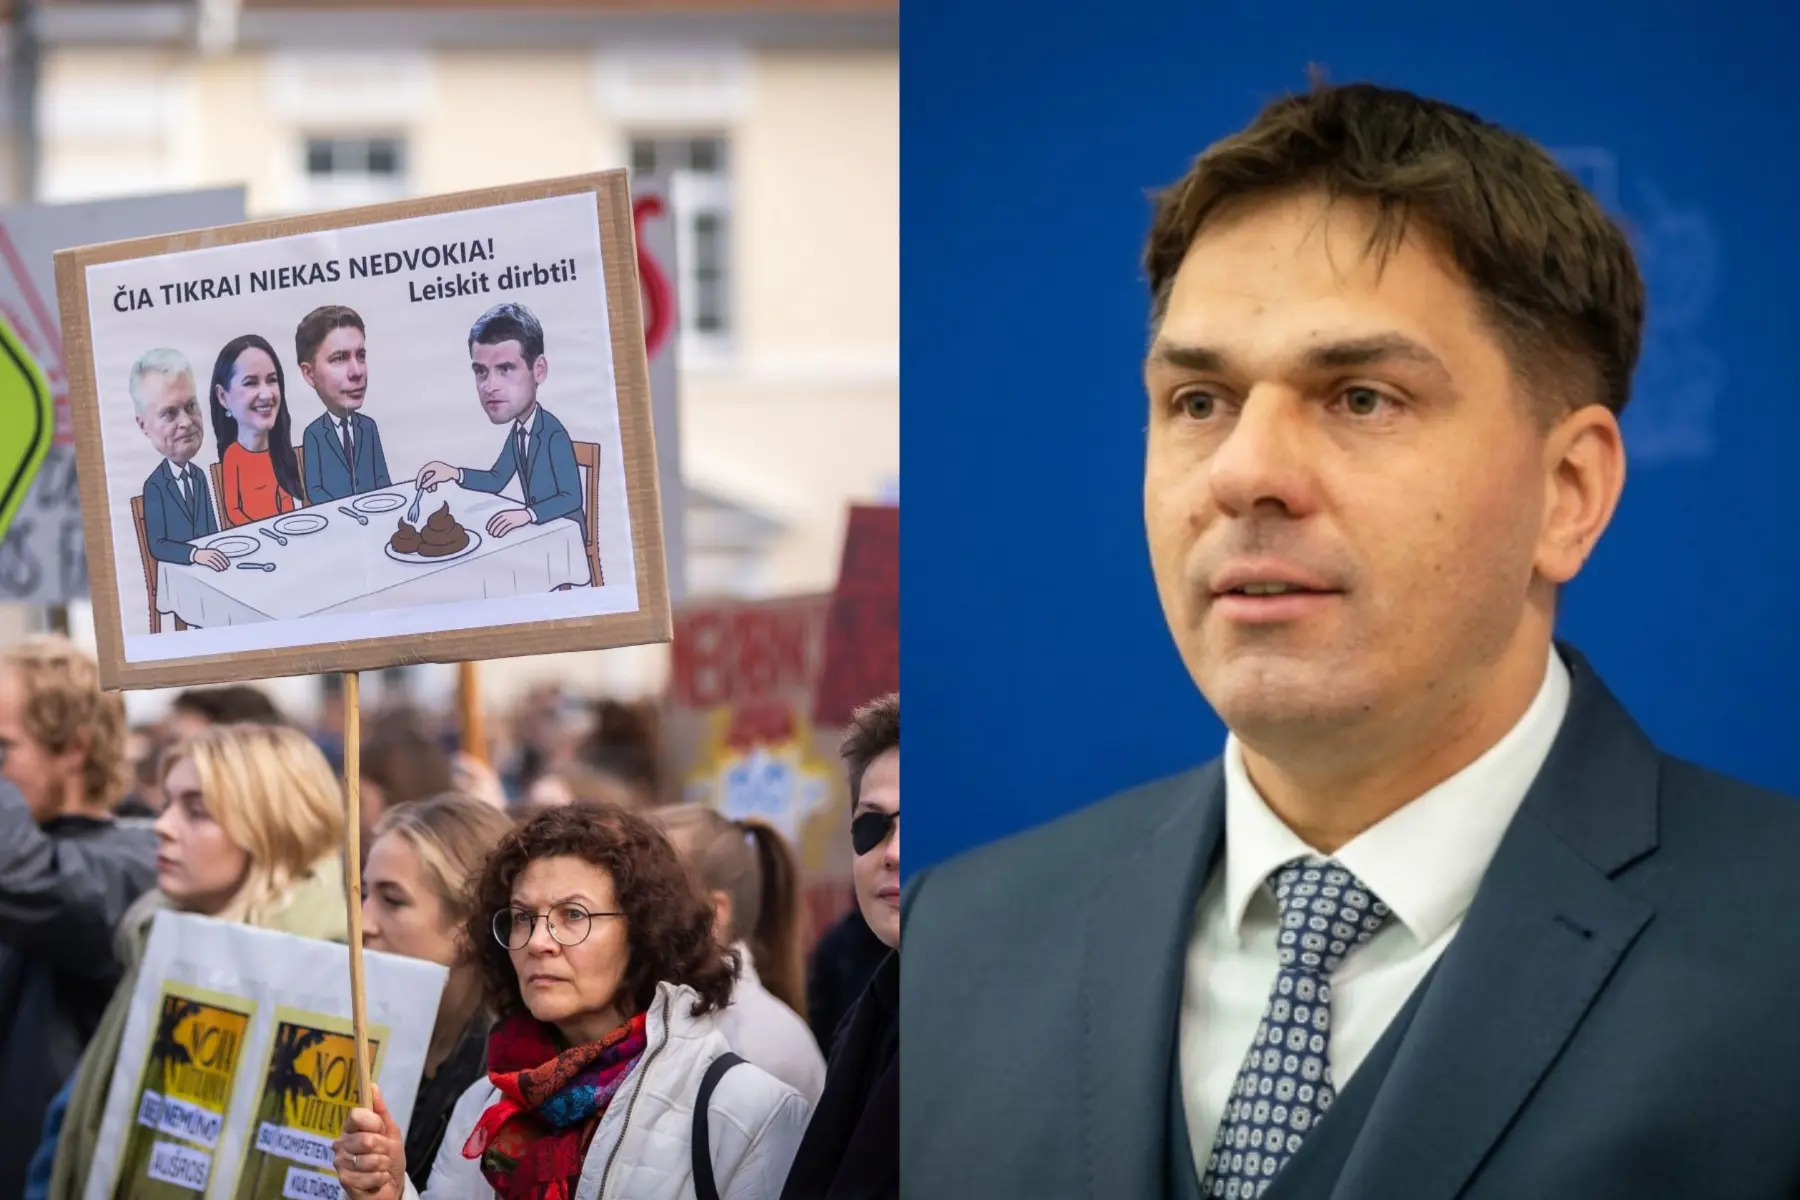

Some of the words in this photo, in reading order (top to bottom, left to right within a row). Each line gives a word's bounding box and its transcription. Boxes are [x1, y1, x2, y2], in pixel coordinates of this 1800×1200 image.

[113, 285, 154, 312] ČIA
[160, 274, 241, 305] TIKRAI
[249, 260, 341, 293] NIEKAS
[348, 238, 495, 279] NEDVOKIA!
[409, 272, 490, 303] Leiskit
[497, 259, 577, 290] dirbti!
